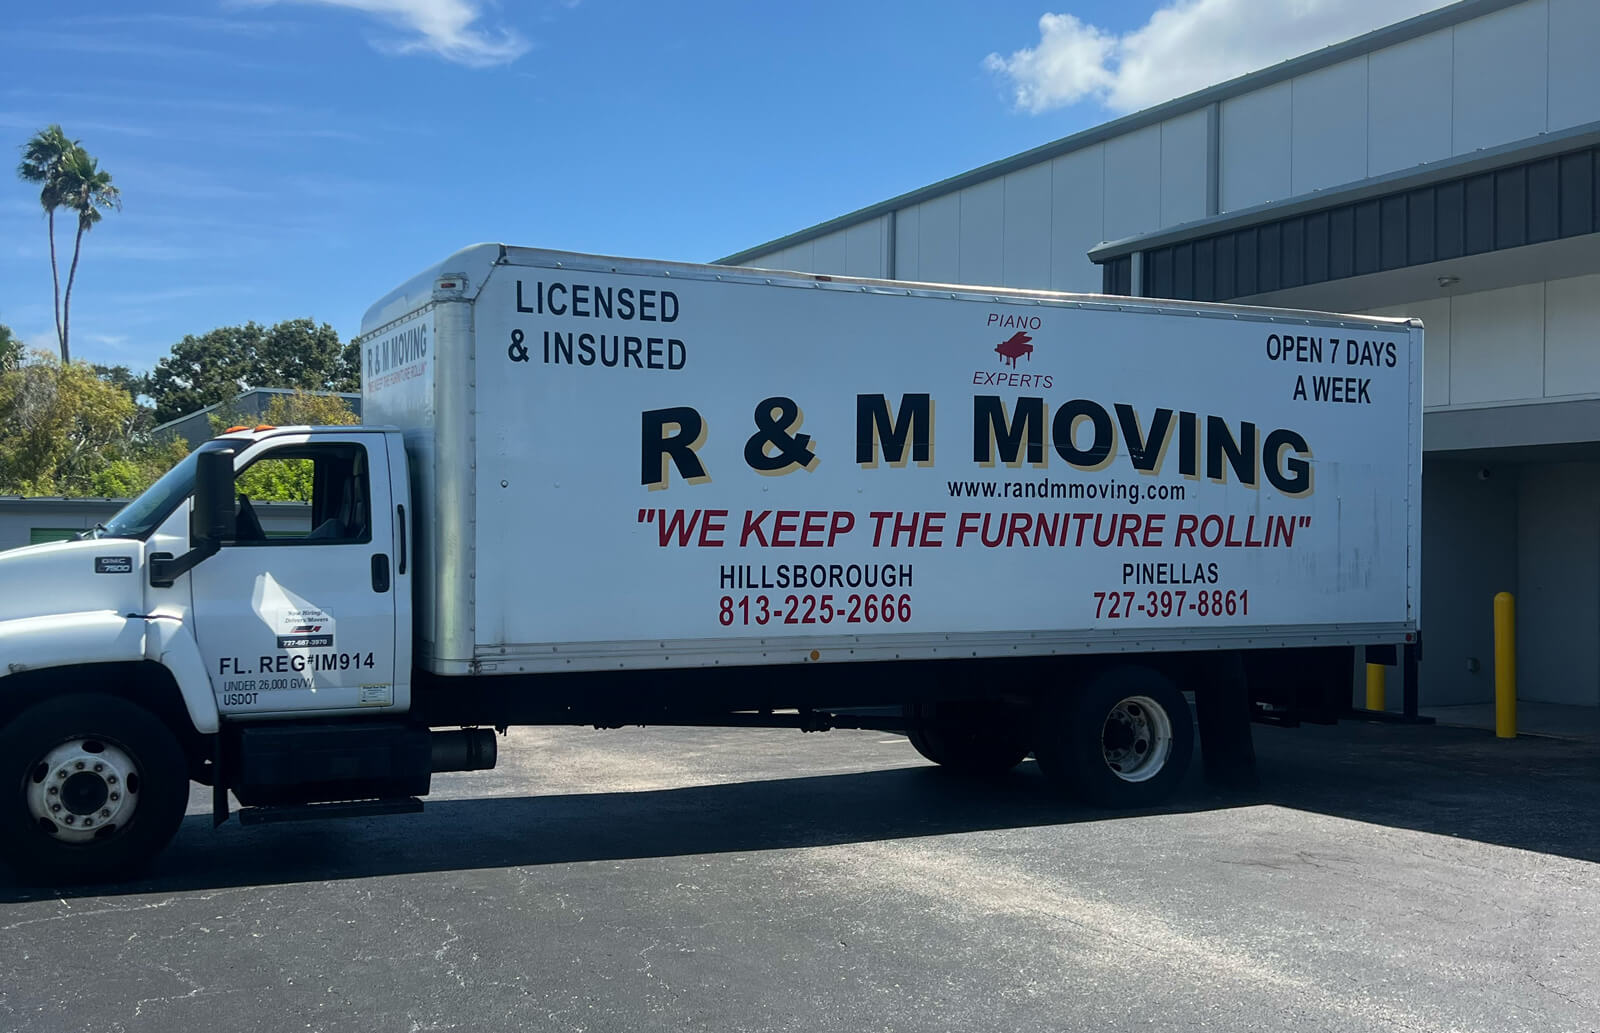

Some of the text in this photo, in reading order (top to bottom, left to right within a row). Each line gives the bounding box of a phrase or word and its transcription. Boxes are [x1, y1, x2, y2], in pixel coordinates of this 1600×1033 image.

[516, 280, 679, 322] LICENSED
[987, 313, 1041, 330] PIANO
[391, 324, 426, 368] MOVING
[508, 329, 686, 370] & INSURED
[1266, 334, 1397, 368] OPEN 7 DAYS
[973, 371, 1053, 389] EXPERTS
[1293, 375, 1371, 404] A WEEK
[641, 393, 1315, 499] R & M MOVING
[948, 478, 1185, 504] www.randmmoving.com
[637, 508, 1311, 548] "WE KEEP THE FURNITURE ROLLIN"
[720, 564, 913, 589] HILLSBOROUGH
[1123, 562, 1218, 585] PINELLAS
[719, 594, 911, 626] 813-225-2666
[1093, 589, 1249, 619] 727-397-8861
[219, 657, 252, 675] FL.
[224, 678, 314, 692] UNDER 26,000 GVW
[224, 692, 258, 706] USDOT
